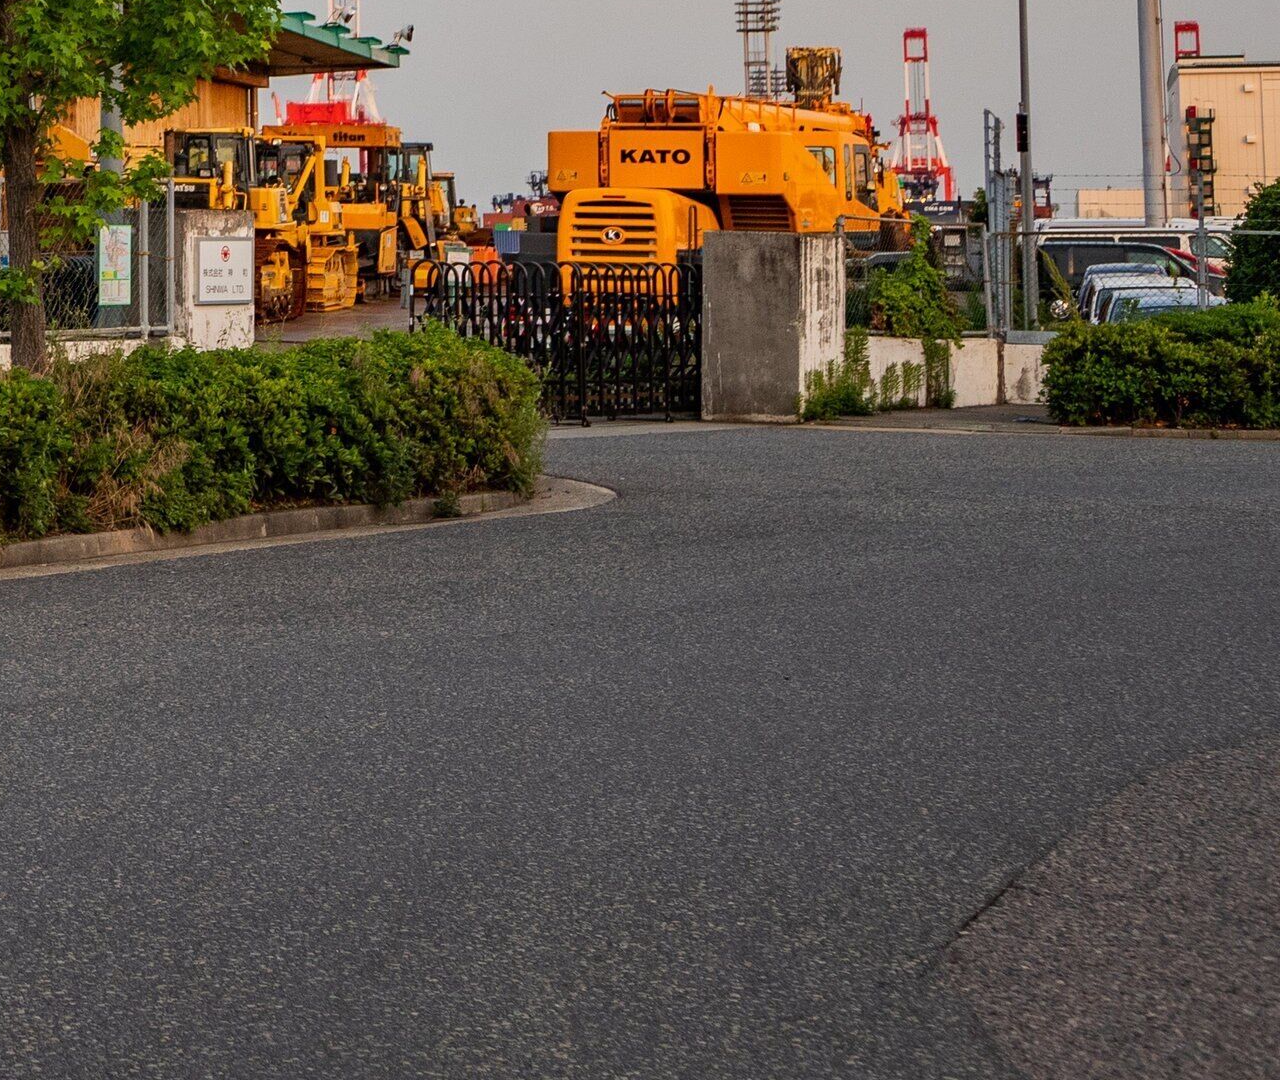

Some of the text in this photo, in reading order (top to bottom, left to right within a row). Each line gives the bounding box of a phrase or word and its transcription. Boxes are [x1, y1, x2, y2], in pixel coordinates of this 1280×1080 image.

[333, 132, 365, 141] titan
[620, 149, 690, 164] KATO
[205, 285, 228, 294] SHINWA
